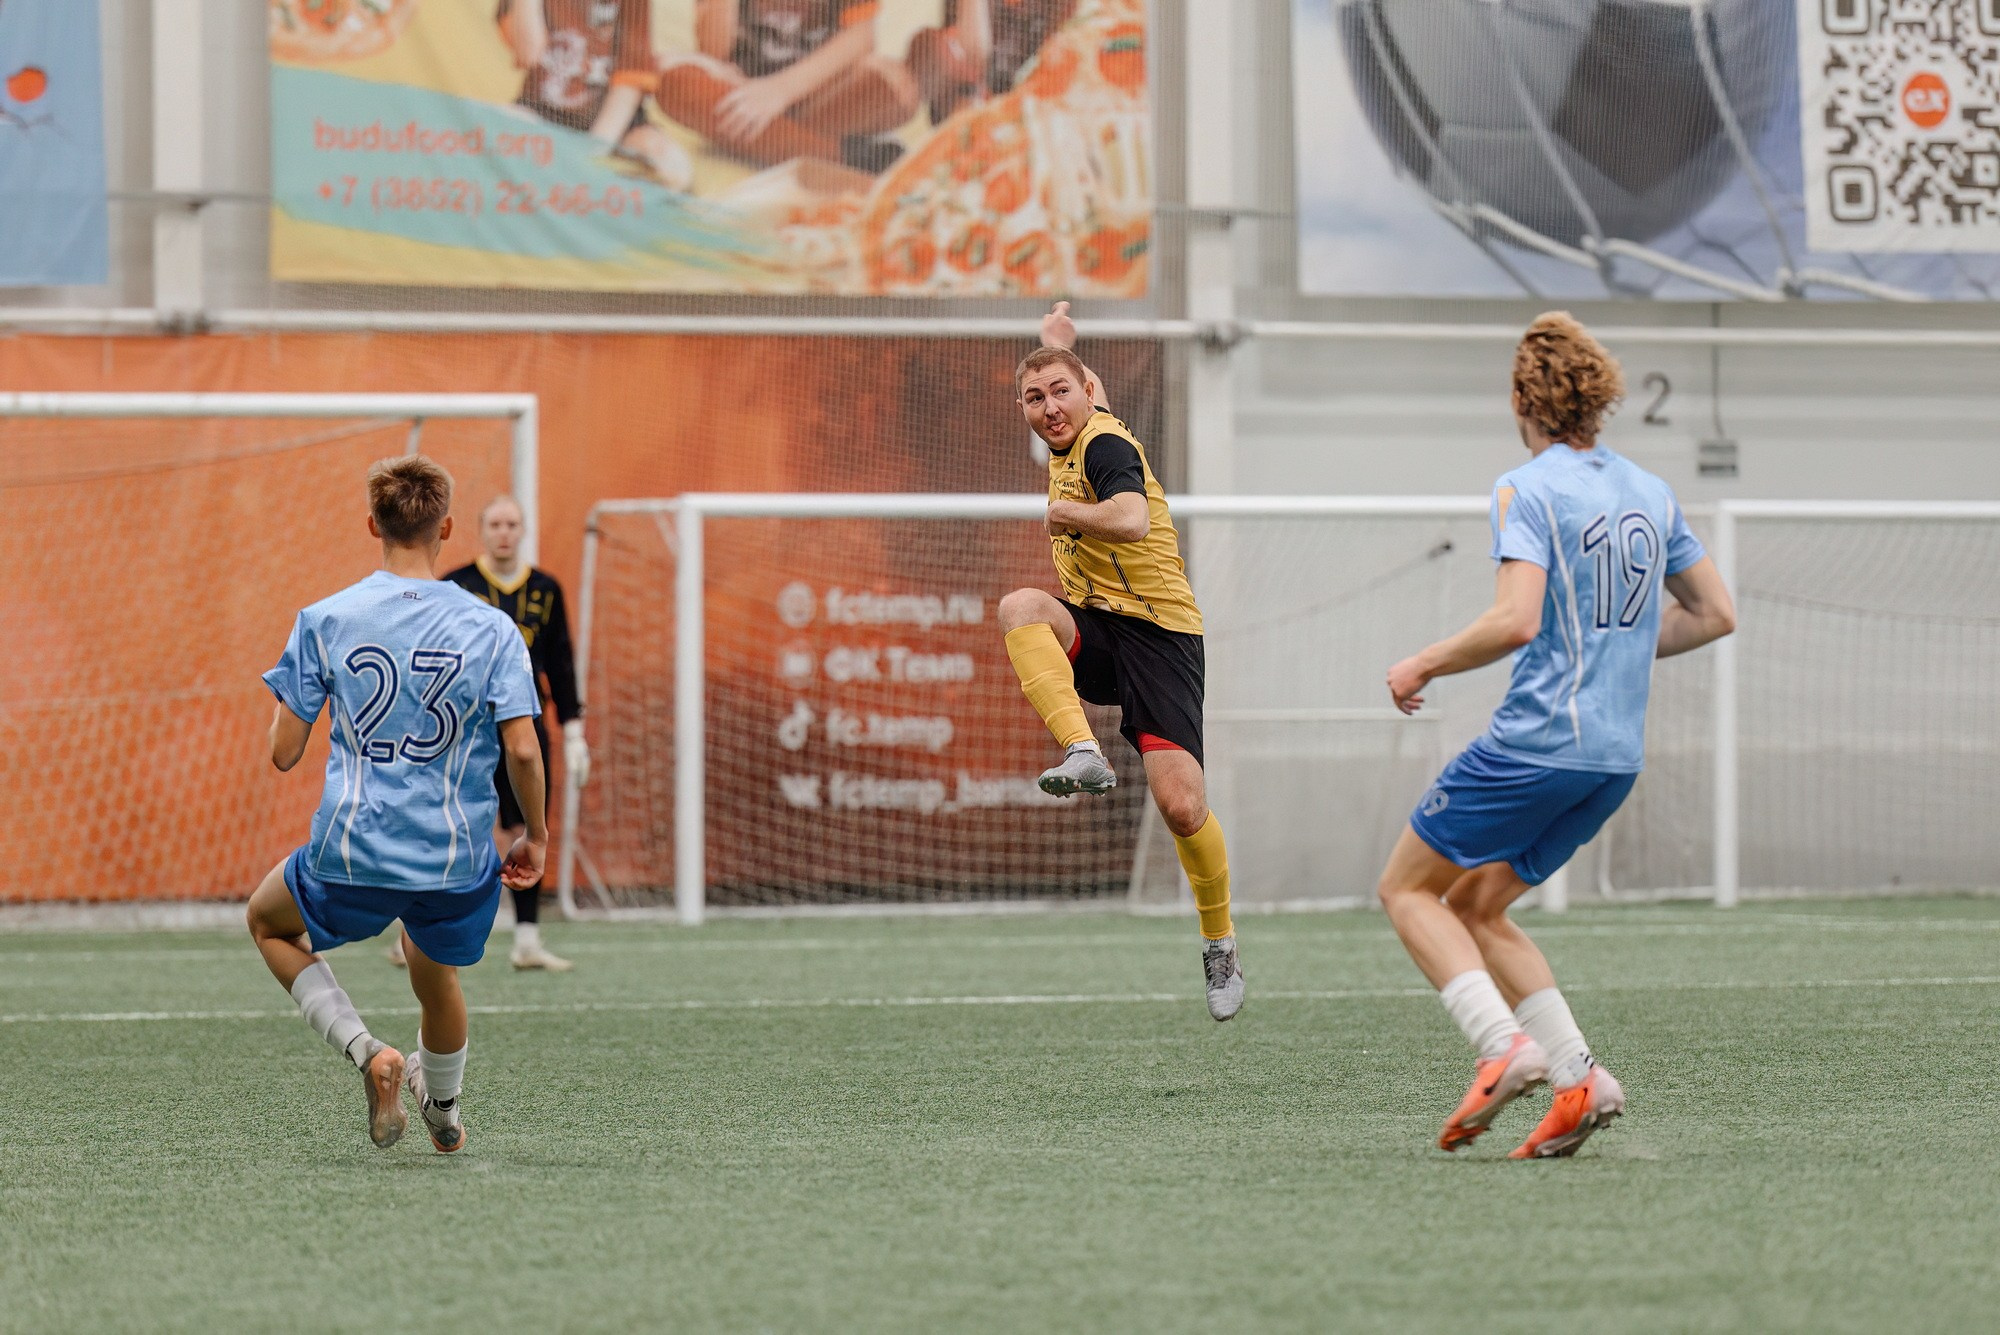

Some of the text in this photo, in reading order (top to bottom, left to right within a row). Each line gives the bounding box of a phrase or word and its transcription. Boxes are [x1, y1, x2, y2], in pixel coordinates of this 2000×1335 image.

[313, 117, 554, 167] budufood.org
[318, 175, 358, 207] +7
[371, 176, 483, 219] (3852)
[1643, 371, 1671, 426] 2
[1580, 510, 1660, 632] 19
[343, 643, 464, 766] 23
